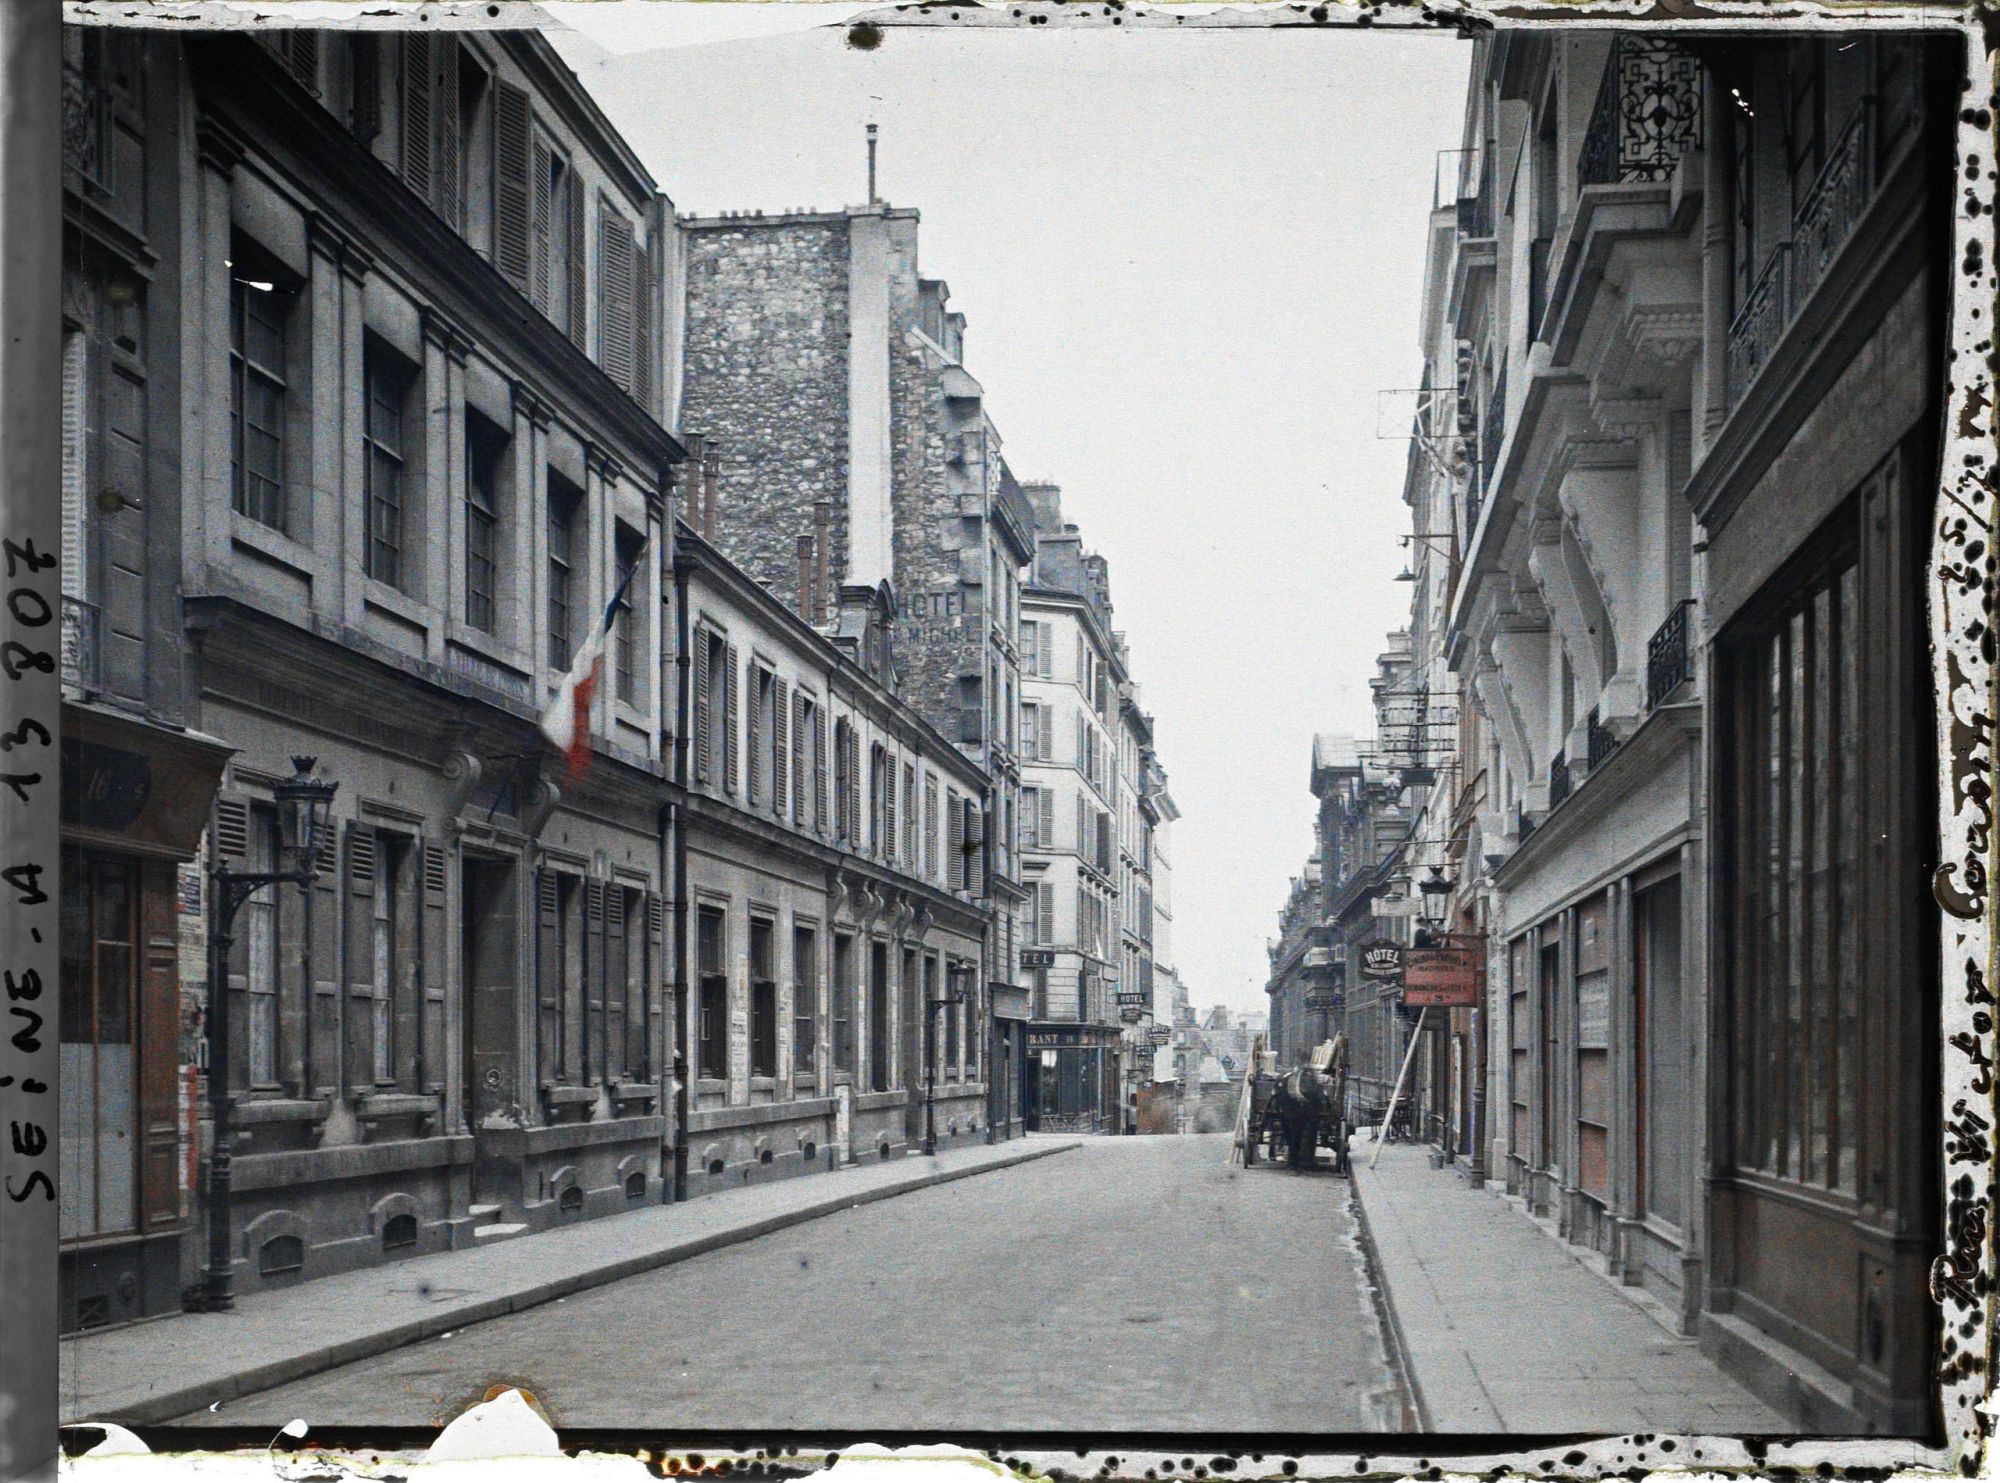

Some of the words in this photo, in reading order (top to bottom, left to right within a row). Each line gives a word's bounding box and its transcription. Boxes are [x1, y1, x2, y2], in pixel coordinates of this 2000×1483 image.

[2, 537, 57, 682] 807
[2, 716, 53, 807] 13
[2, 861, 52, 906] A
[1119, 993, 1144, 1003] HOTEL
[1027, 1033, 1059, 1044] RANT
